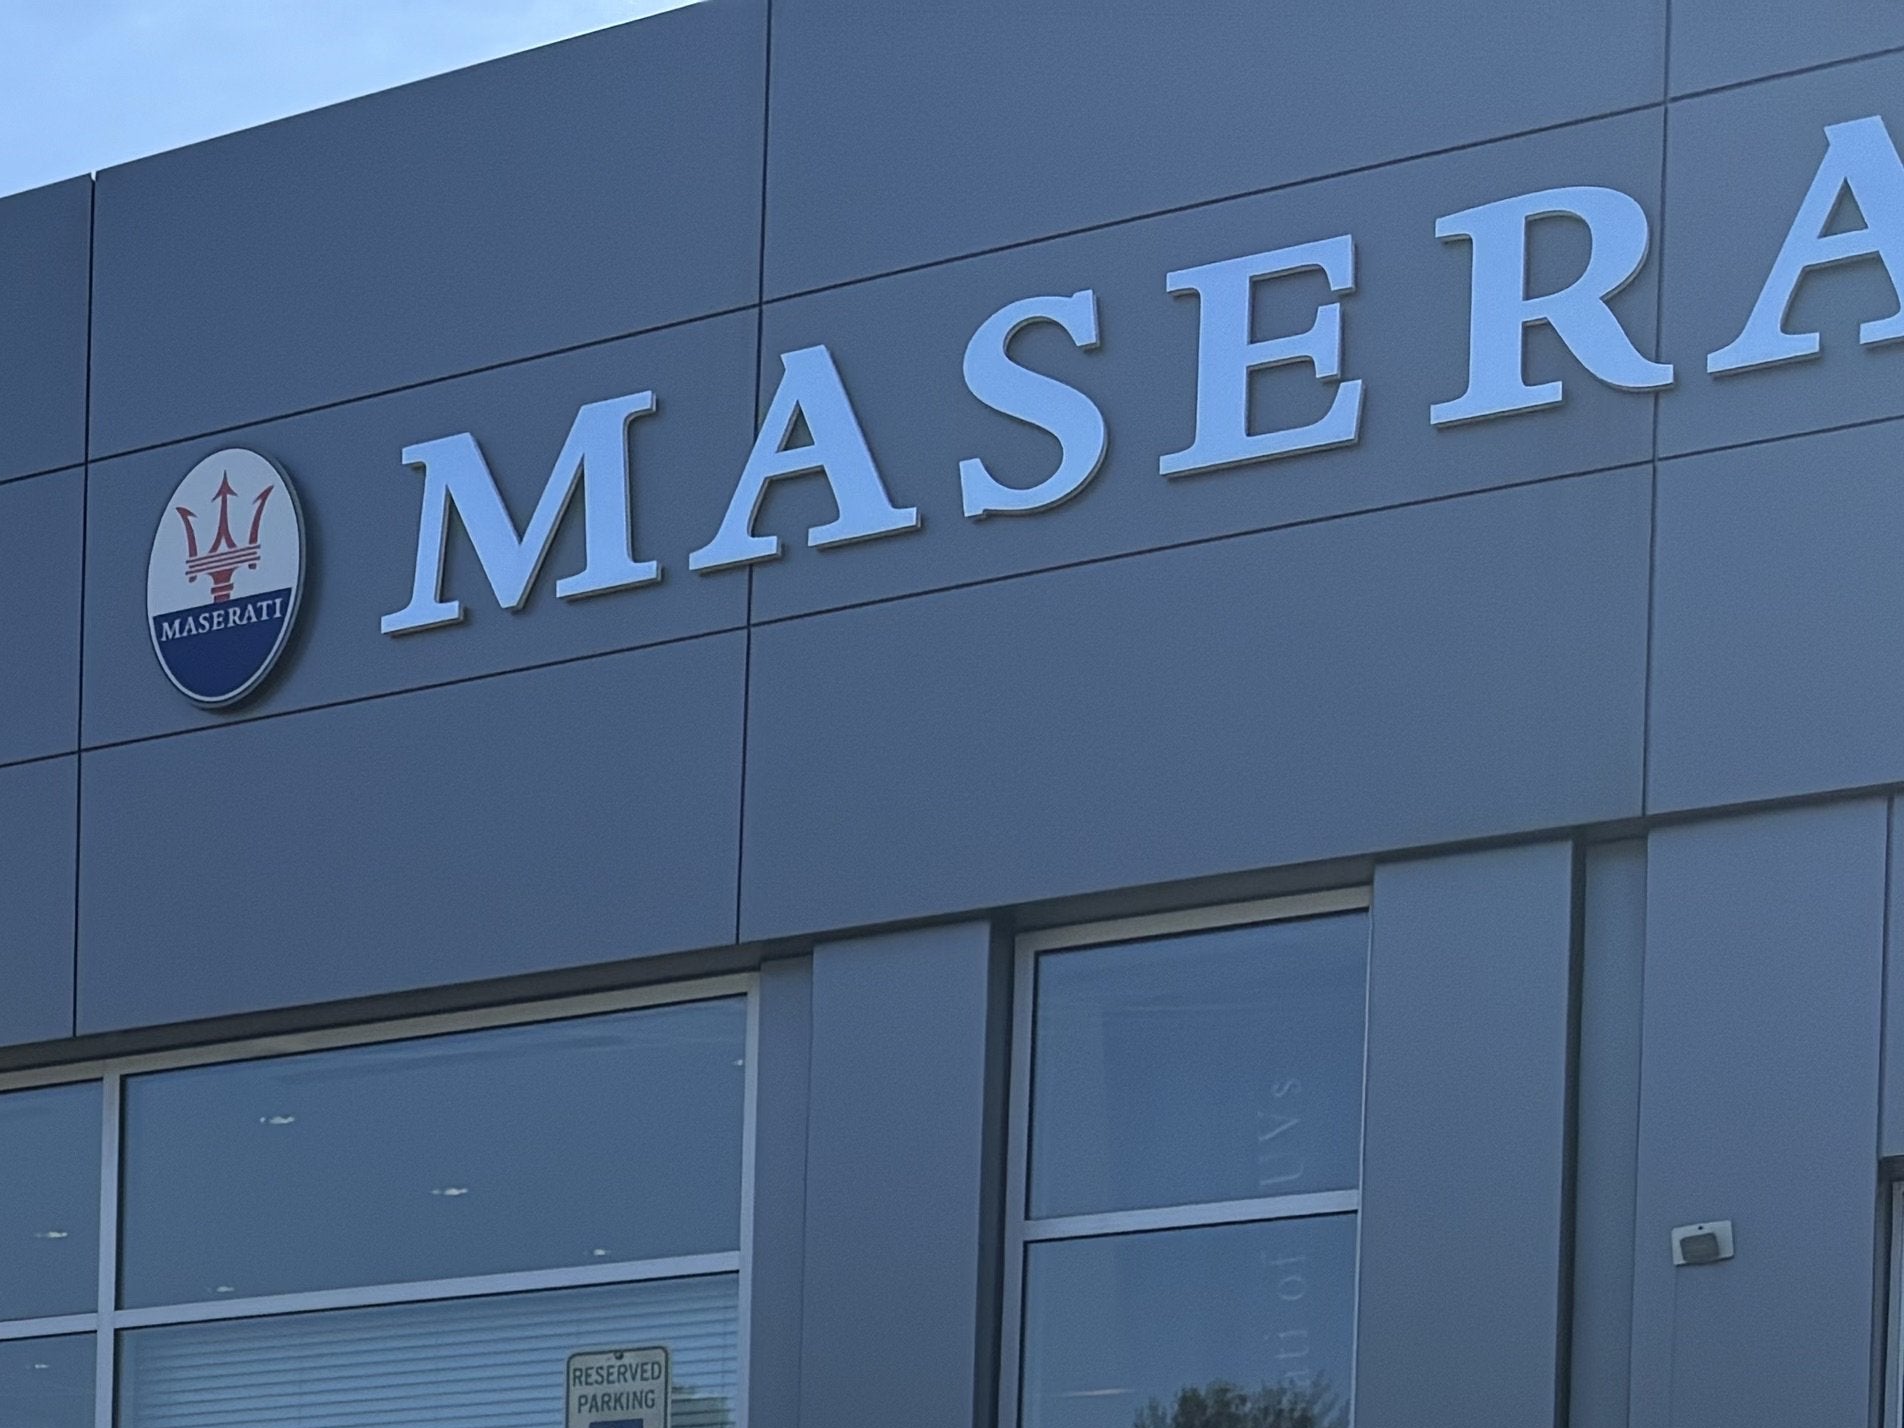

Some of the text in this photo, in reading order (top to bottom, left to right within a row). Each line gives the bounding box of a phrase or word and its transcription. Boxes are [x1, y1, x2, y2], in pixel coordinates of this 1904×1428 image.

[160, 597, 284, 642] MASERATI
[572, 1360, 663, 1388] RESERVED
[577, 1388, 656, 1415] PARKING
